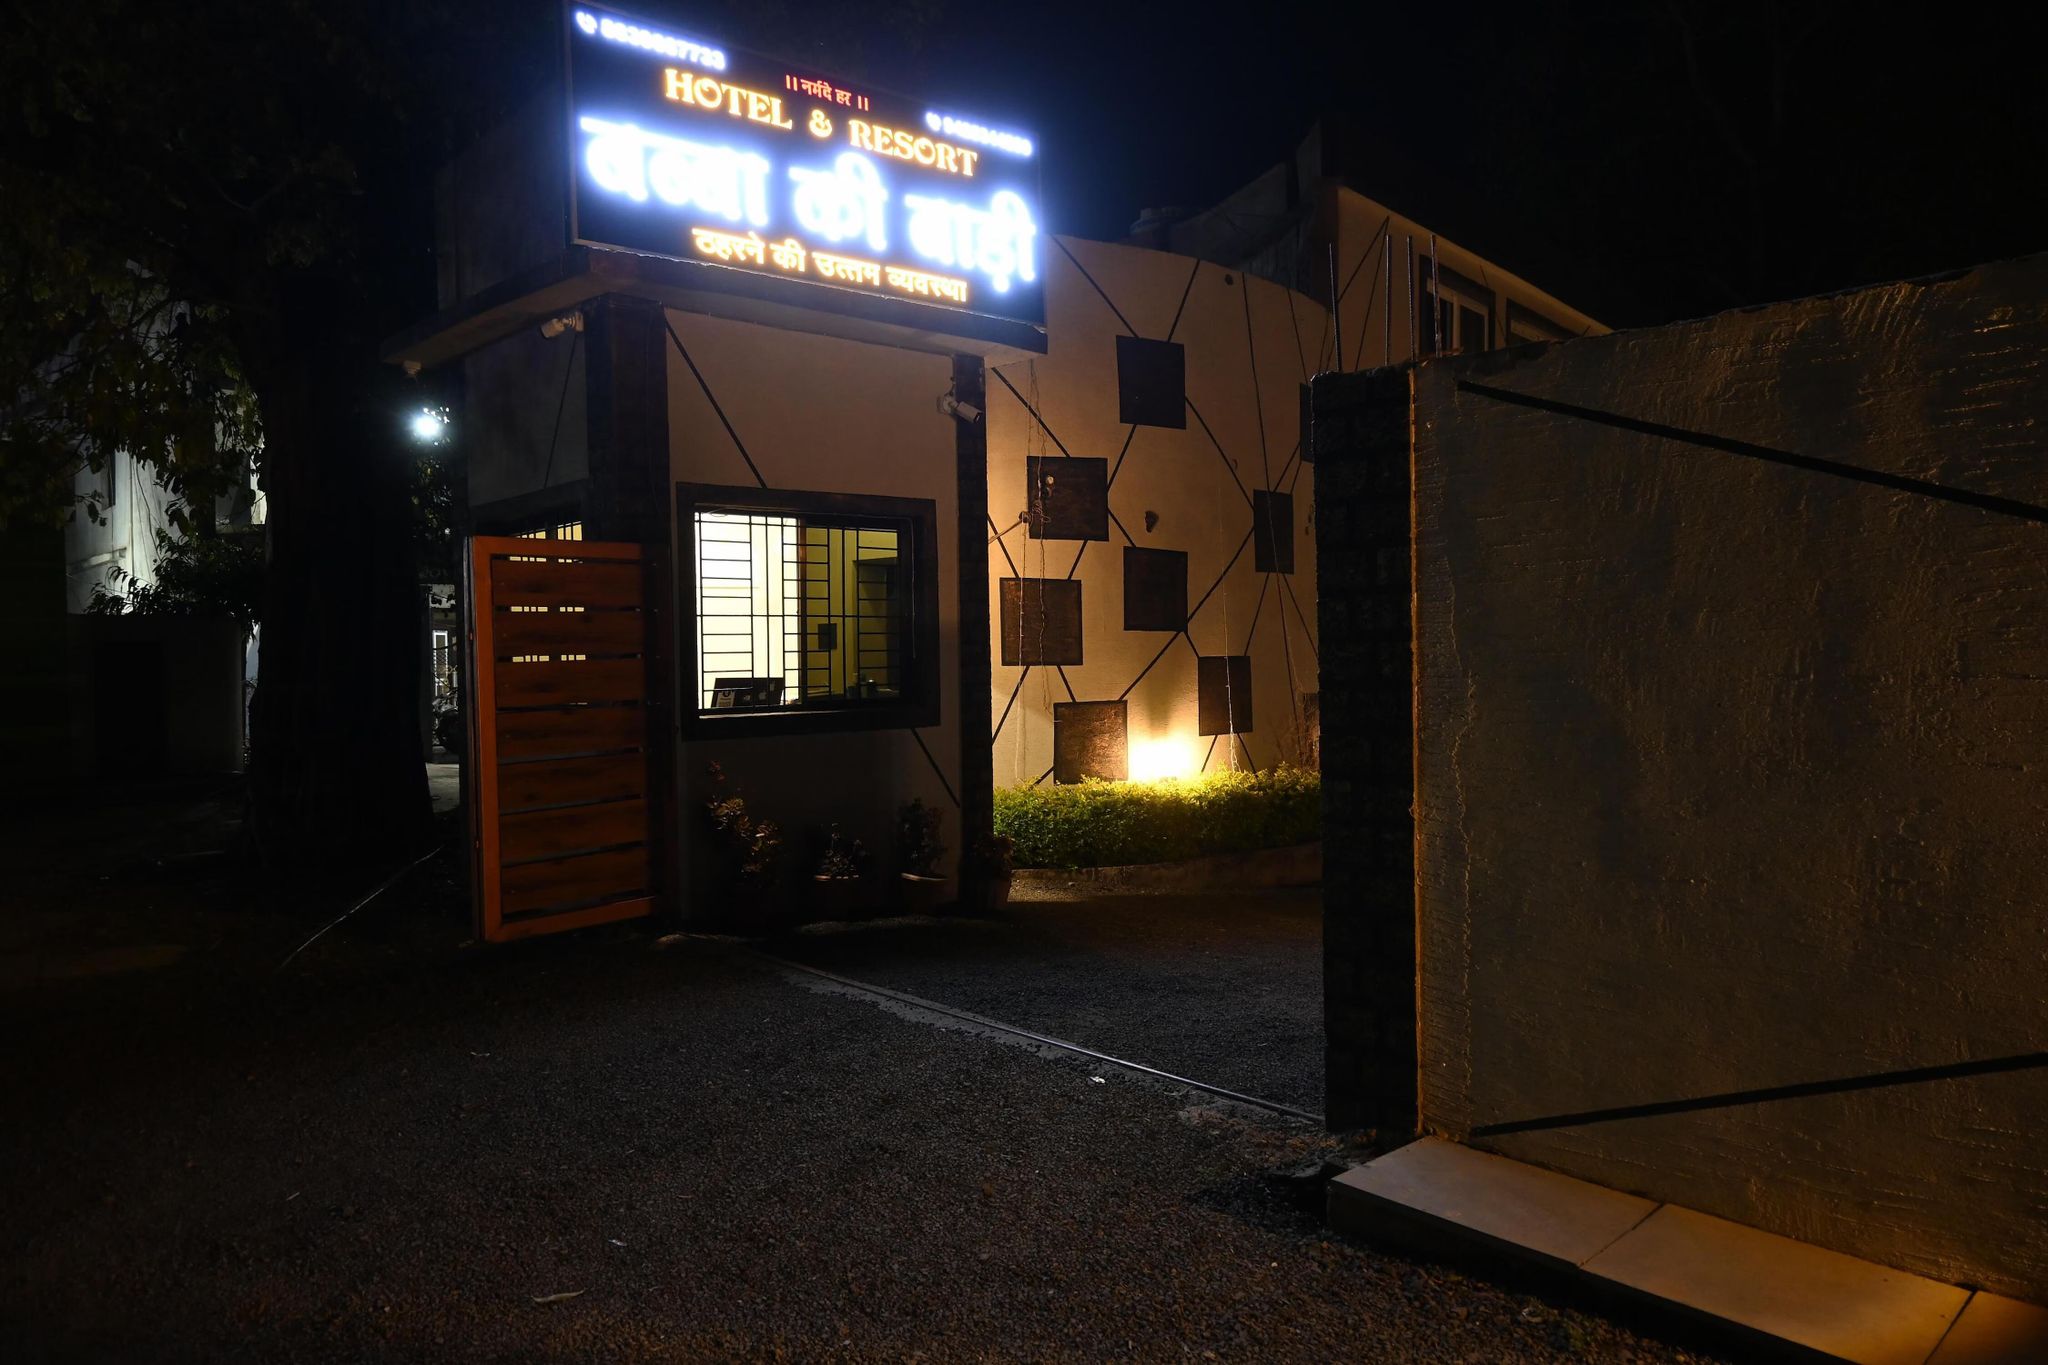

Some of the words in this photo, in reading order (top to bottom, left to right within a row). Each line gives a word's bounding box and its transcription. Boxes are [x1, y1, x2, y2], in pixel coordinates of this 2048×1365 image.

[665, 69, 792, 129] HOTEL
[809, 111, 832, 137] &
[850, 119, 978, 176] RESORT
[801, 79, 832, 101] नर्मदे
[835, 89, 851, 106] हर
[790, 153, 885, 248] की
[692, 228, 765, 264] ठहरने
[770, 239, 806, 272] की
[812, 251, 880, 286] उत्तम
[885, 266, 968, 302] व्यवस्था
